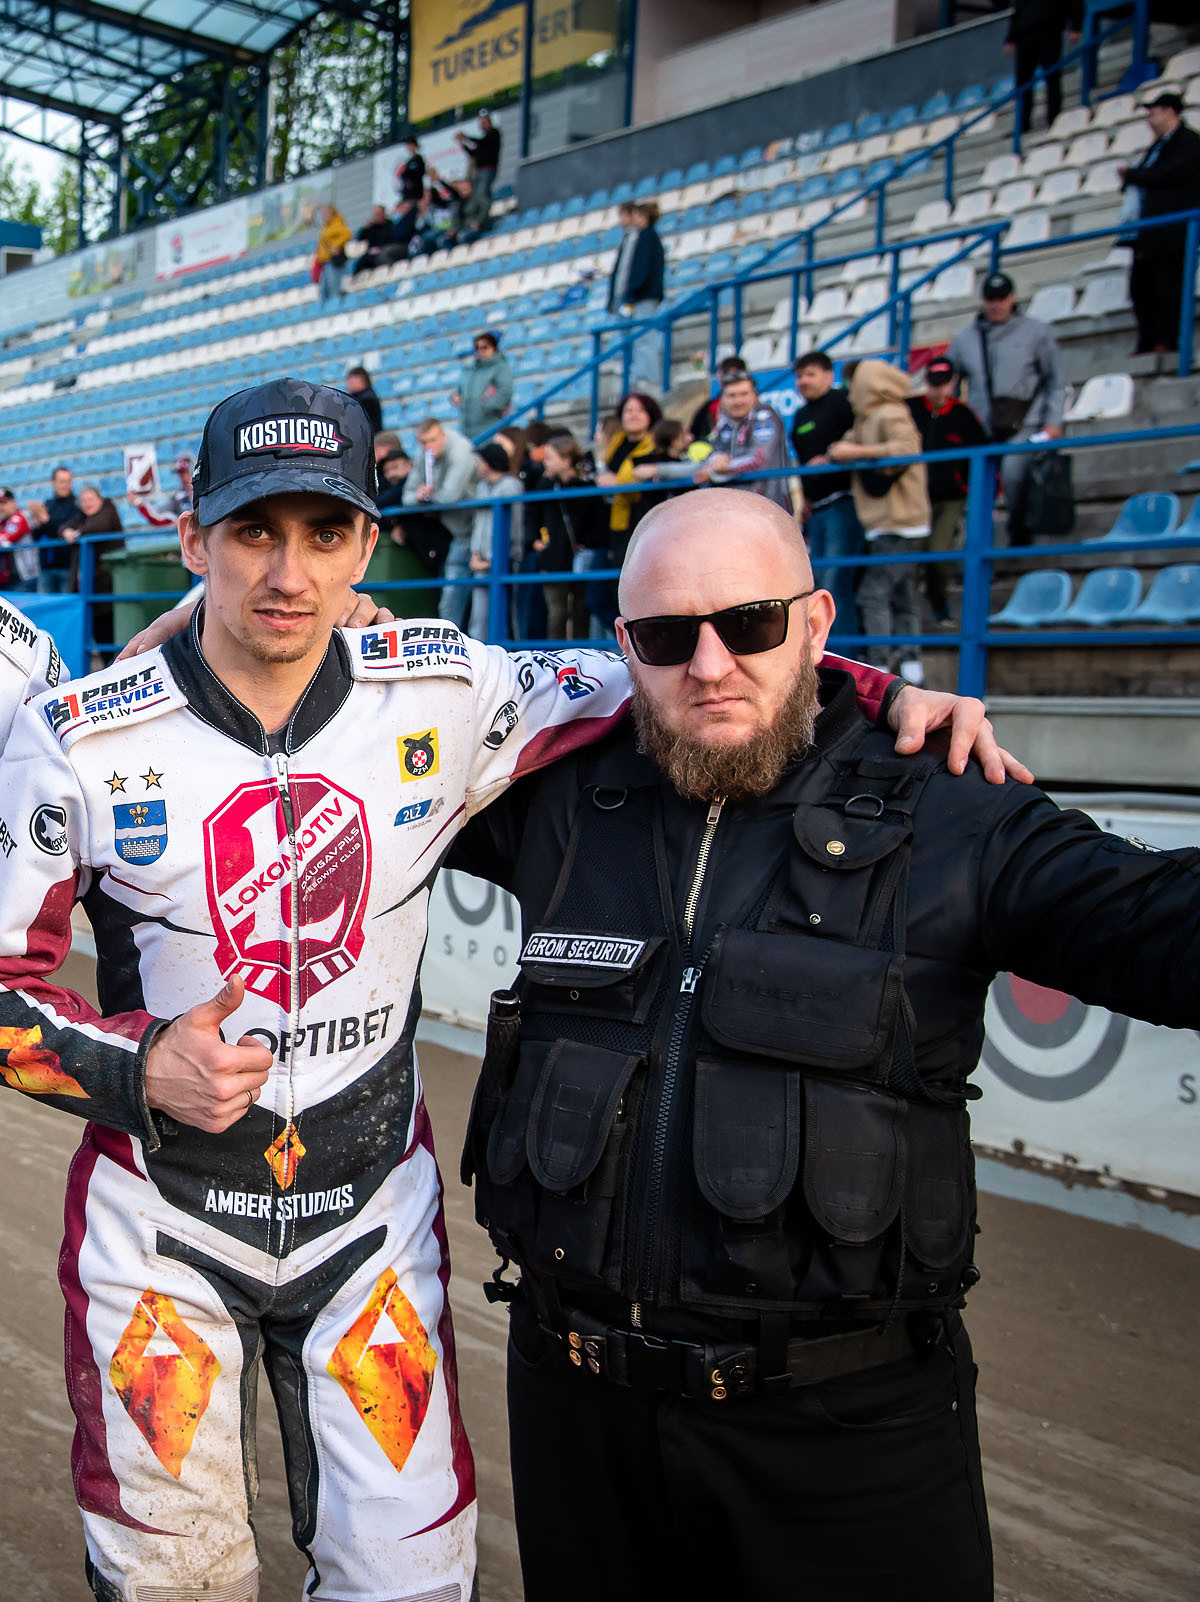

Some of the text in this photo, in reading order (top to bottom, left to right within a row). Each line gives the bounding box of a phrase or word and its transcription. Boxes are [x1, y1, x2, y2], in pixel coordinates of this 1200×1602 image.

[240, 418, 335, 453] KOSTIGOV
[313, 435, 339, 452] 113
[402, 627, 466, 645] PAR
[402, 643, 471, 661] SERVIC
[407, 656, 449, 671] ps1.lv
[81, 666, 157, 704] PART
[84, 681, 164, 714] SERVICE
[90, 708, 131, 725] ps1.lv
[339, 842, 361, 863] CLUB
[526, 937, 640, 963] GROM SECURITY
[204, 1184, 354, 1222] AMBER STUDIOS
